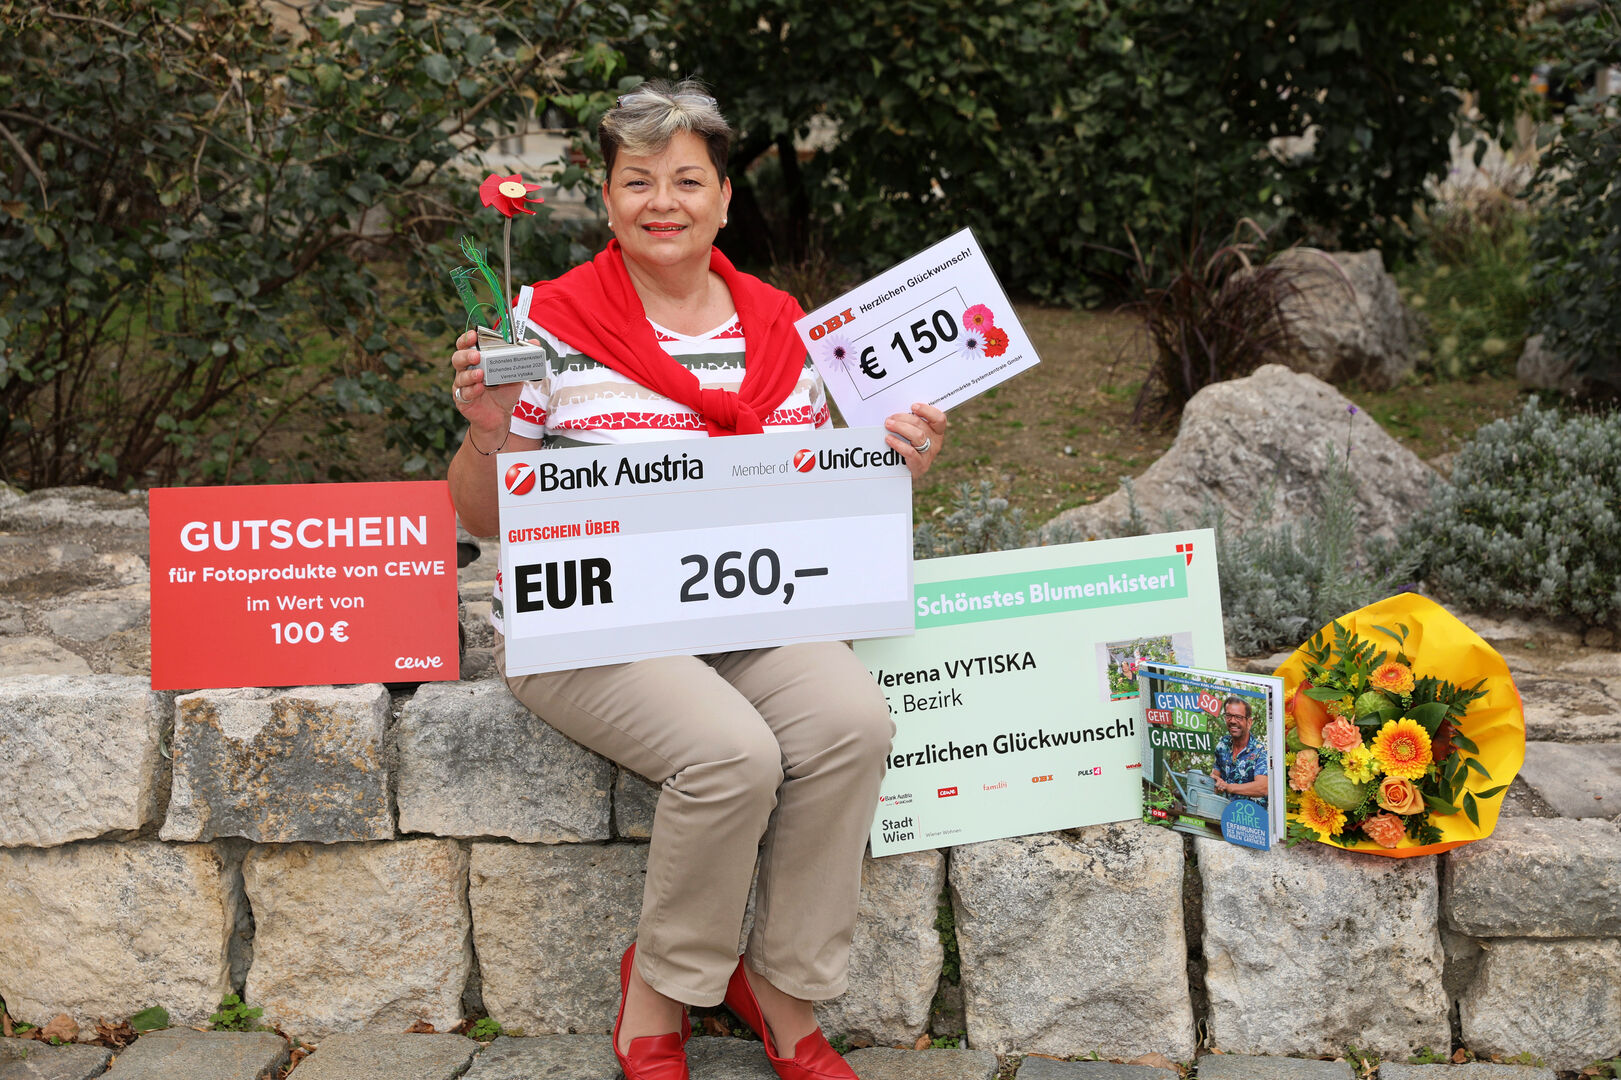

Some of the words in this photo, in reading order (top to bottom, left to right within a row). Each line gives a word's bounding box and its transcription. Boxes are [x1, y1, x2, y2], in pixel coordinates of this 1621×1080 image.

[859, 284, 906, 314] Herzlichen
[906, 248, 972, 288] Glückwunsch!
[809, 308, 856, 341] OBI
[859, 346, 887, 380] €
[890, 309, 958, 364] 150
[970, 363, 1007, 386] Systemzentrale
[1006, 354, 1023, 368] GmbH
[540, 459, 608, 492] Bank
[614, 452, 704, 486] Austria
[732, 462, 777, 477] Member
[778, 460, 790, 475] of
[180, 516, 427, 552] GUTSCHEIN
[508, 524, 581, 544] GUTSCHEIN
[585, 520, 620, 536] ÜBER
[168, 567, 196, 583] für
[203, 563, 337, 583] Fotoprodukte
[343, 562, 378, 578] von
[384, 560, 445, 577] CEWE
[514, 557, 614, 614] EUR
[916, 590, 1025, 617] Schönstes
[1029, 568, 1174, 604] Blumenkisterl
[246, 596, 269, 612] im
[276, 594, 324, 610] Wert
[330, 594, 364, 609] von
[271, 621, 324, 644] 100
[330, 620, 350, 643] €
[394, 655, 443, 669] cewe
[944, 651, 1037, 680] VYTISKA
[903, 688, 963, 713] Bezirk
[1157, 694, 1200, 711] GENAU
[1200, 695, 1218, 714] SO
[1148, 710, 1170, 723] GEHT
[1176, 710, 1206, 730] BIO-
[992, 718, 1135, 752] Glückwunsch!
[1151, 729, 1211, 751] GARTEN!
[1031, 774, 1053, 783] OBI
[1230, 811, 1260, 828] JAHRE
[1236, 802, 1255, 816] 20
[882, 817, 913, 831] Stadt
[1226, 821, 1266, 836] ERFAHRUNGEN
[883, 831, 914, 843] Wien
